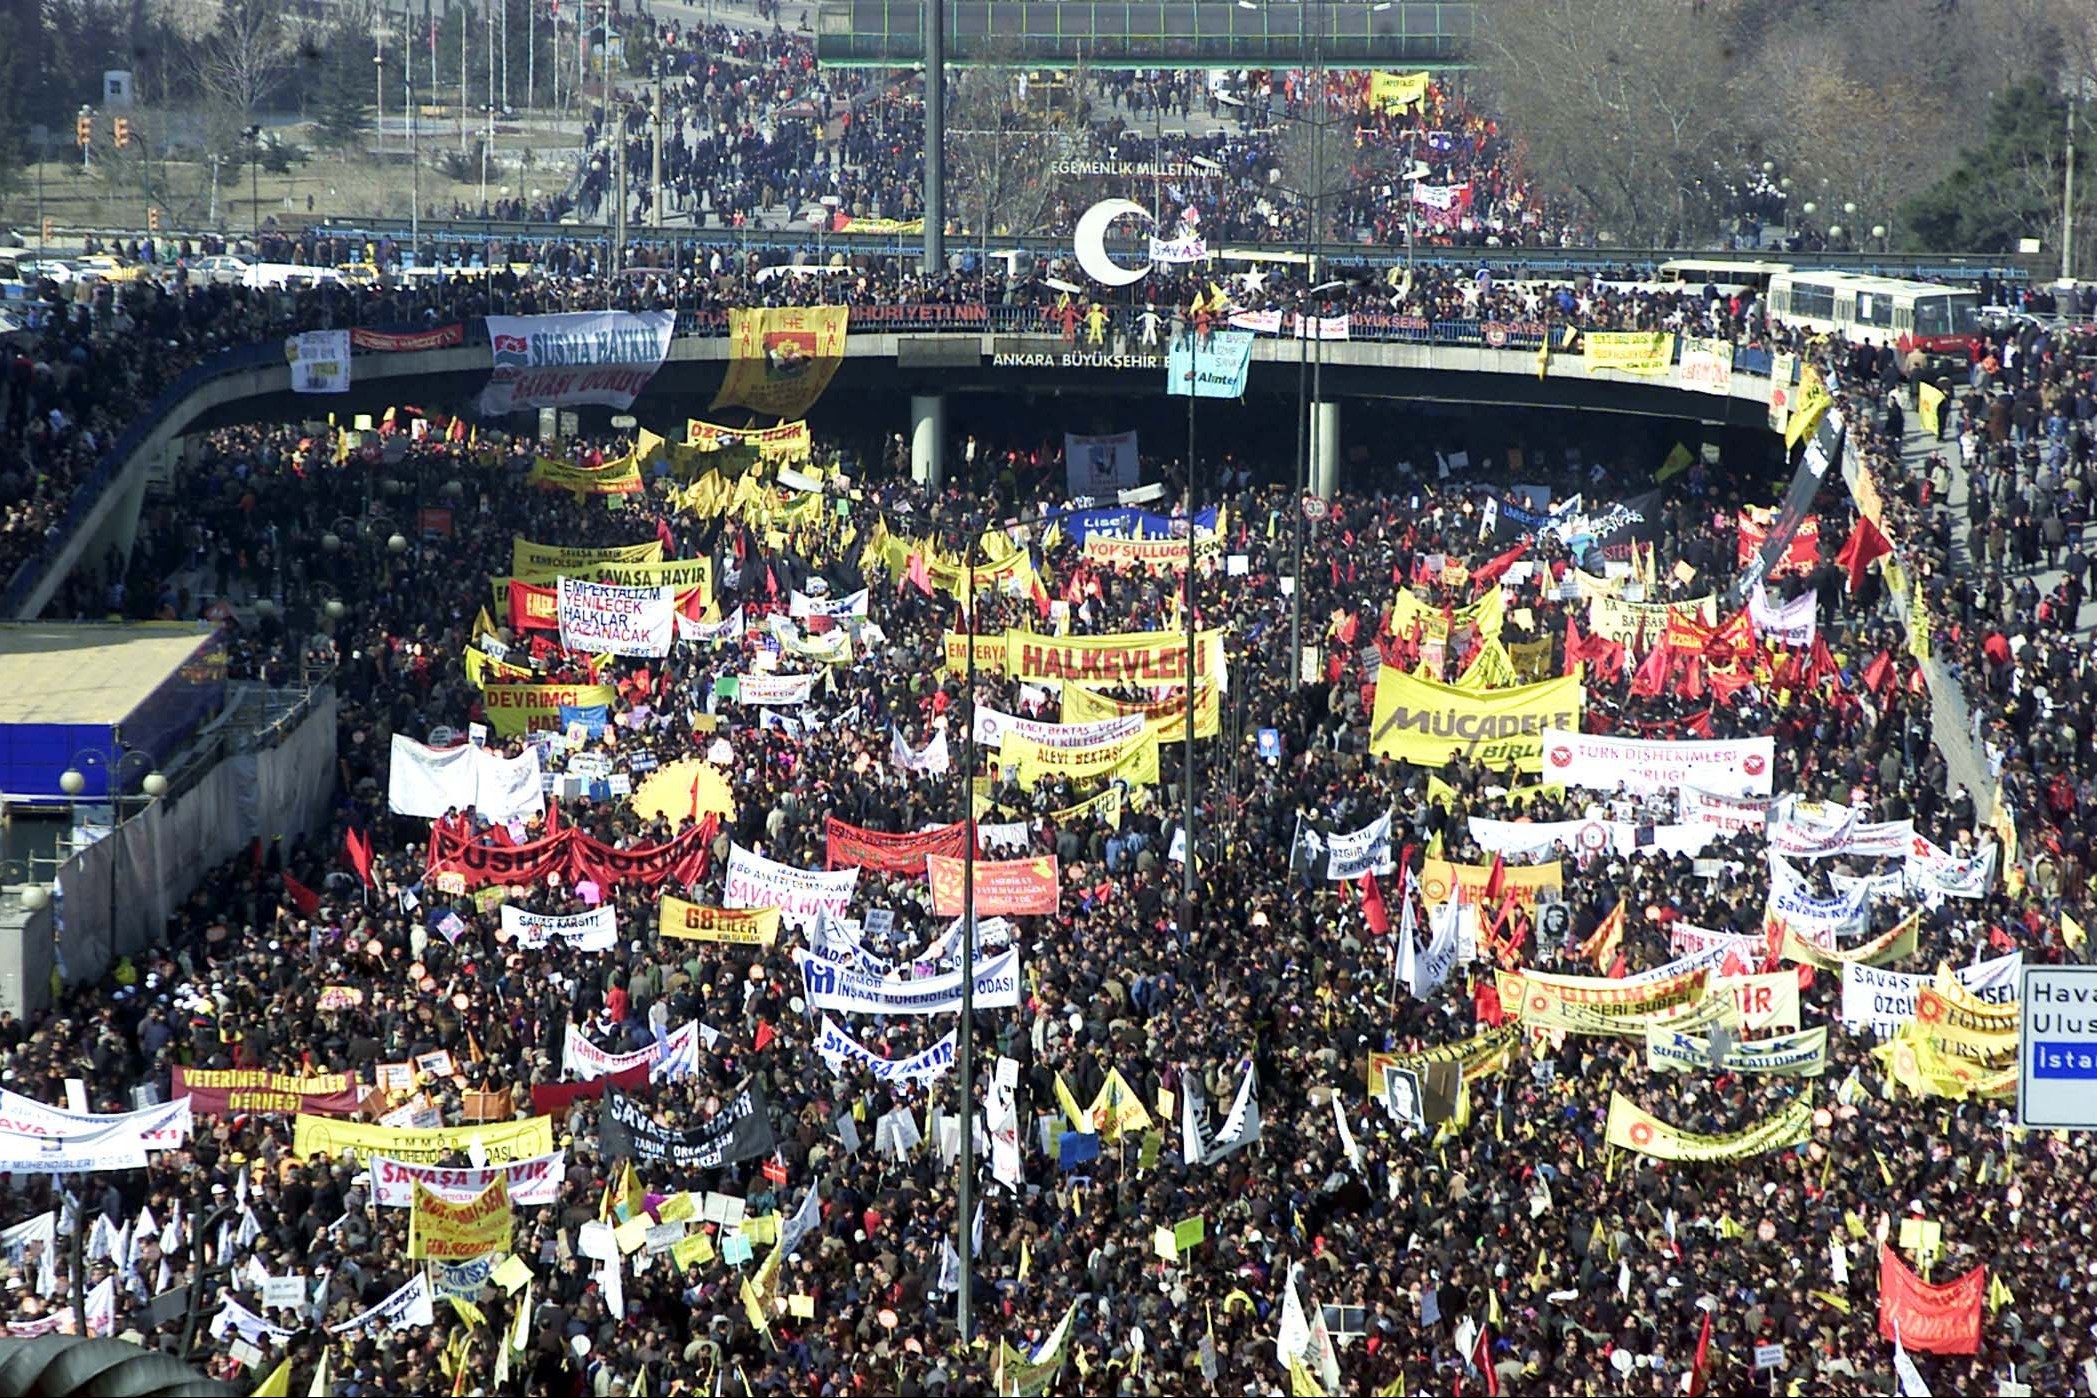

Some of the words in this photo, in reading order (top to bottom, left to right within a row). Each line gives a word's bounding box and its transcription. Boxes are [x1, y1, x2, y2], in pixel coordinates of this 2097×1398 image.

[993, 352, 1055, 368] ANKARA
[1062, 349, 1157, 369] BÜYÜKŞEHİR
[660, 567, 707, 586] HAYIR
[564, 606, 629, 628] HALKLAR
[948, 642, 1006, 660] EMERYA
[1373, 706, 1573, 759] MÜCADELE
[686, 907, 714, 930] 68
[977, 976, 1015, 995] ODASI
[382, 1162, 468, 1191] SAVAŞA
